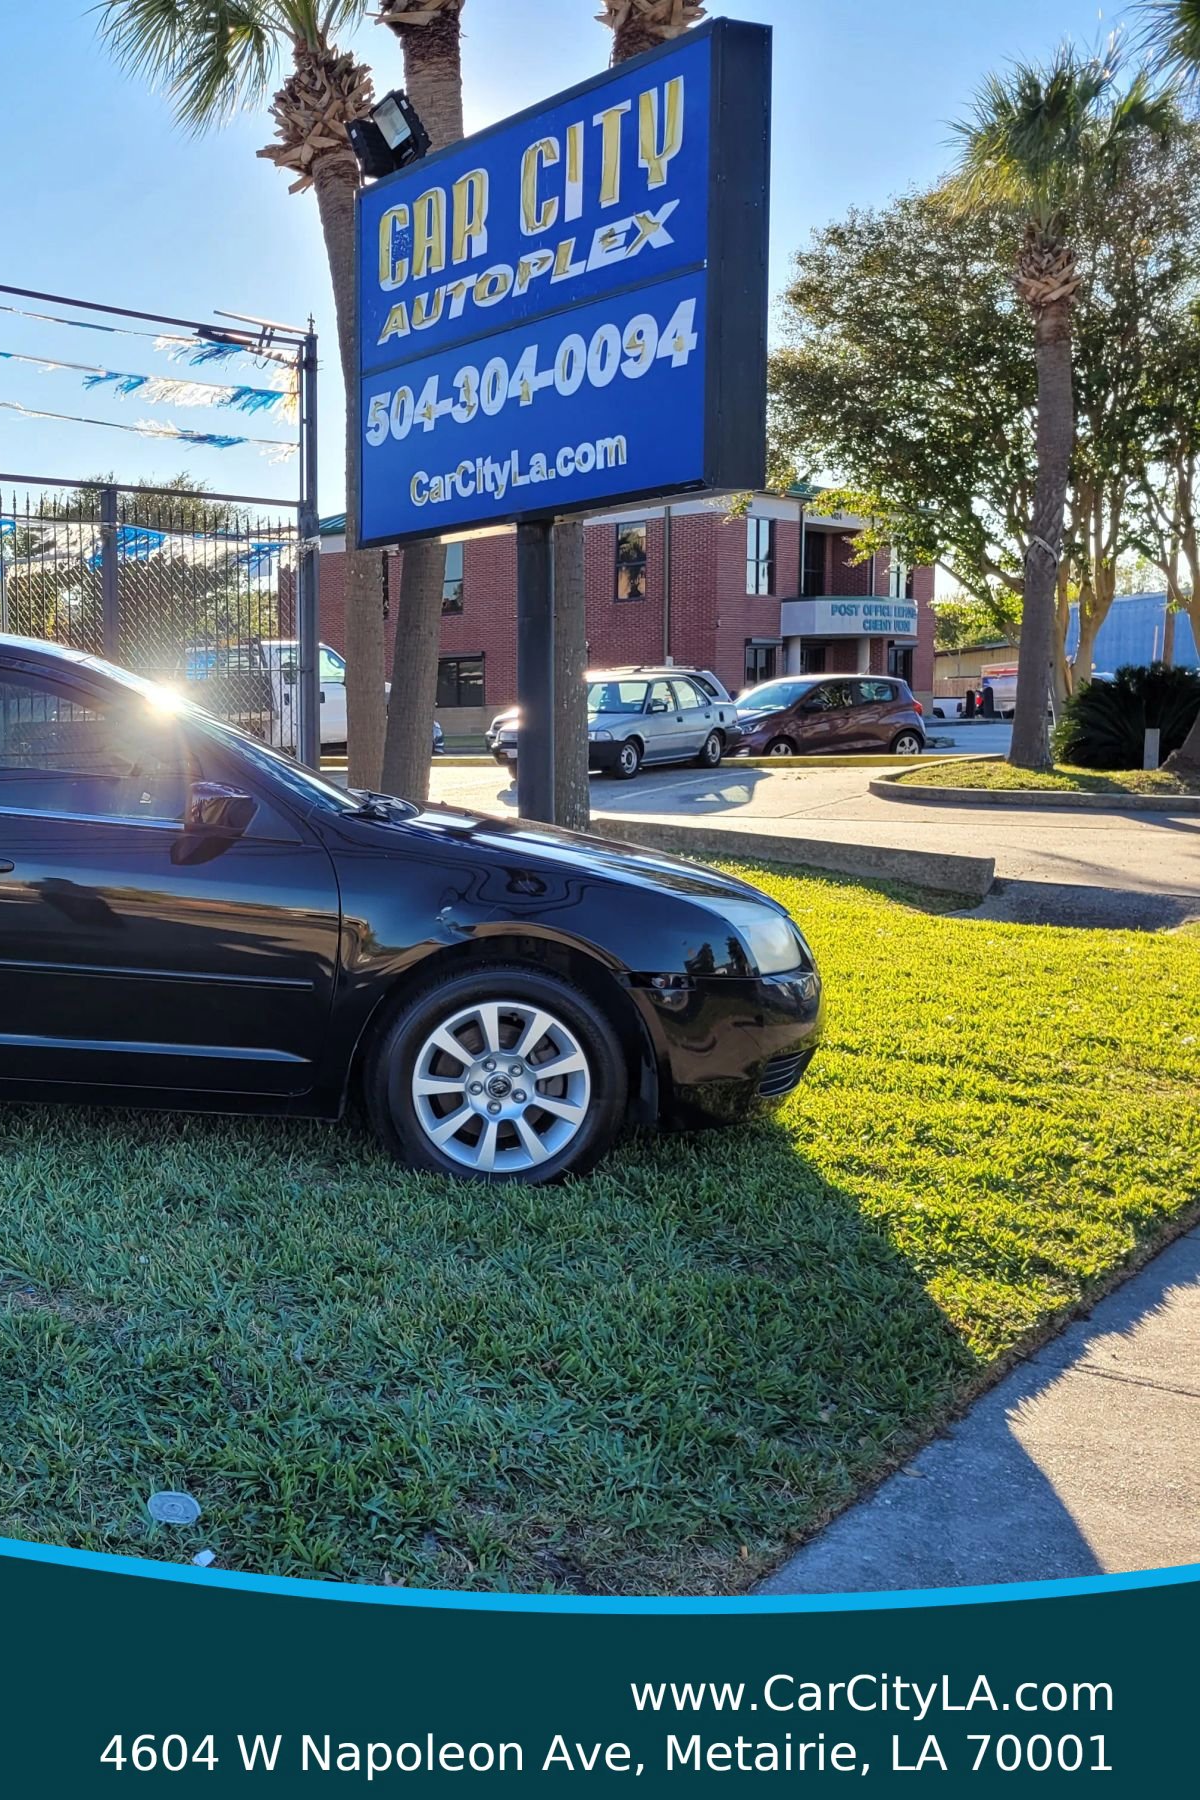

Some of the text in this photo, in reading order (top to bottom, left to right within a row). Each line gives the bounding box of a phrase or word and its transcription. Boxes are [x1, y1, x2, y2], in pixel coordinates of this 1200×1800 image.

[379, 75, 685, 292] CAR CITY
[377, 199, 680, 346] AUTOPLEX
[365, 297, 697, 447] 504-304-0094
[410, 434, 627, 507] CarCityLa.com
[831, 603, 860, 616] POST
